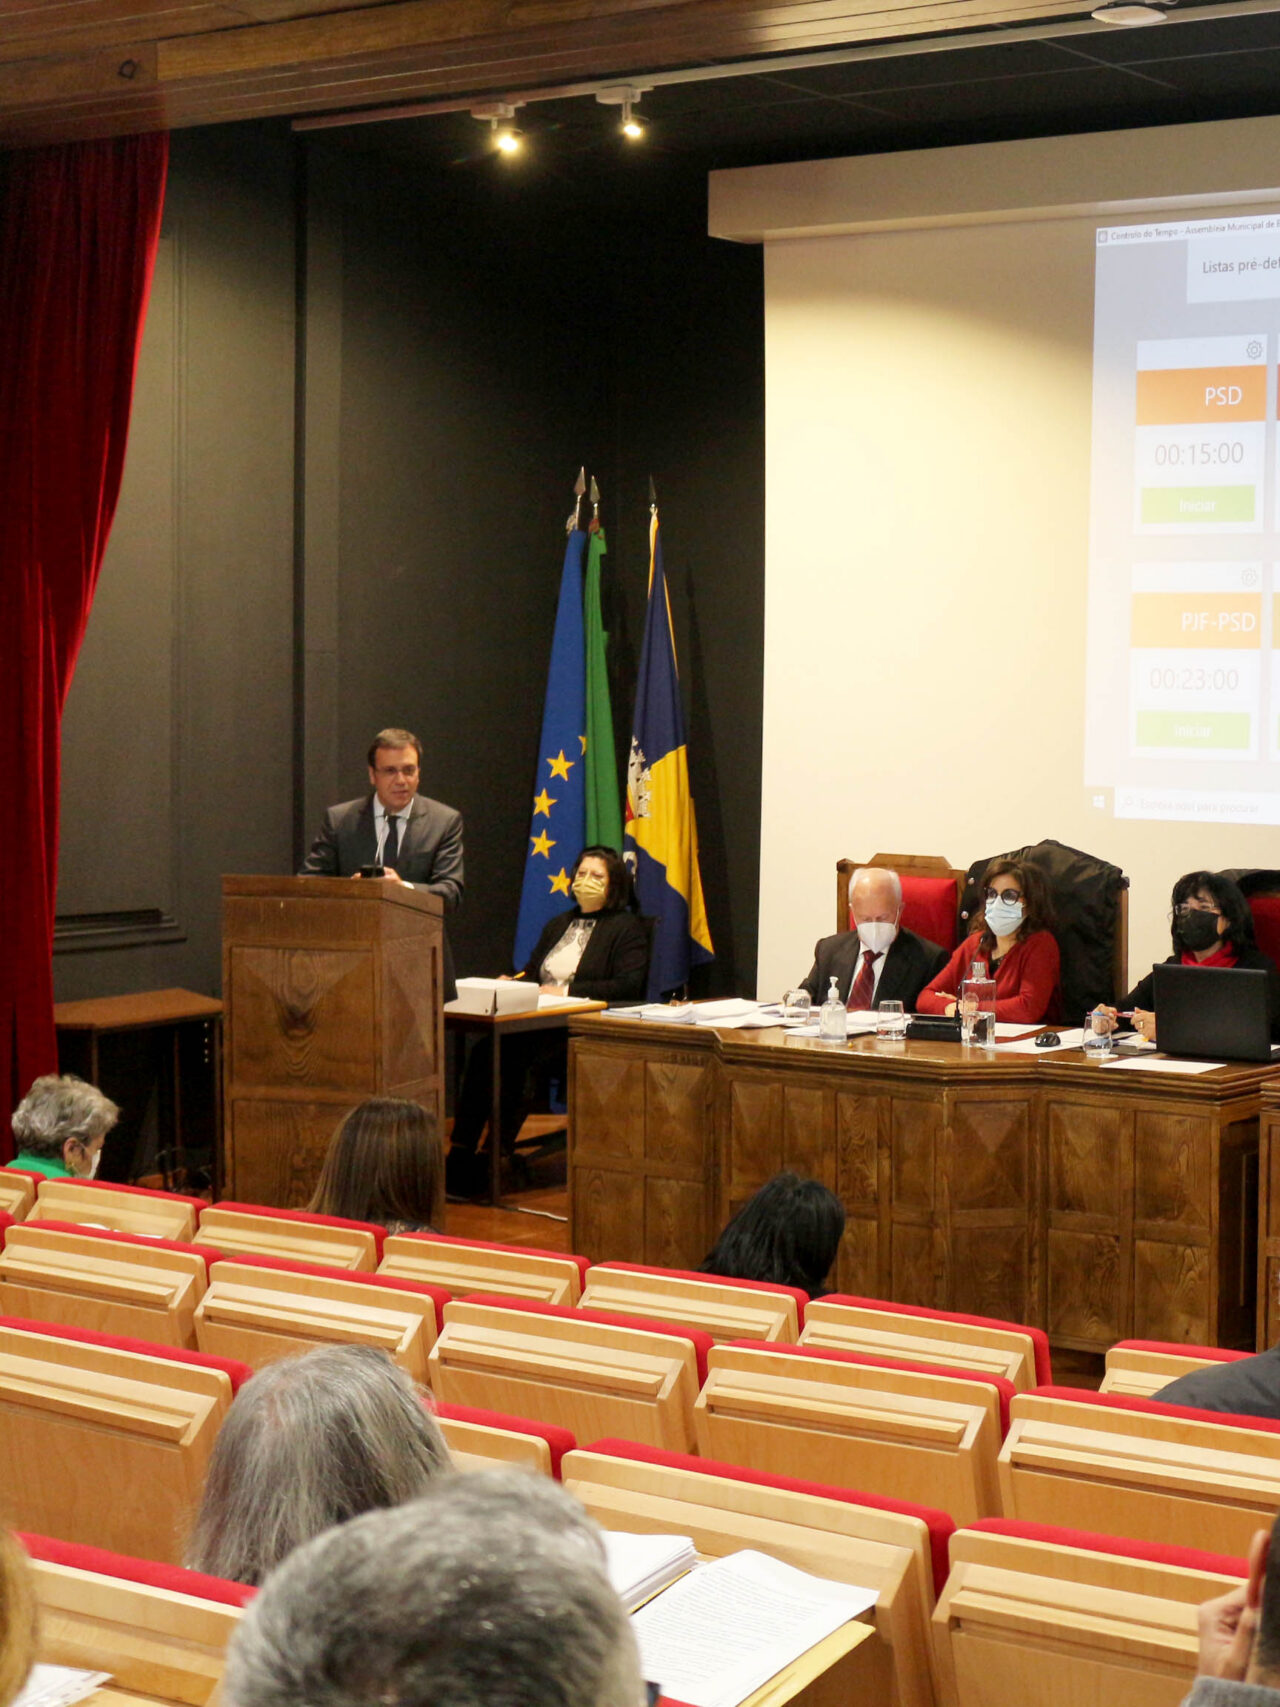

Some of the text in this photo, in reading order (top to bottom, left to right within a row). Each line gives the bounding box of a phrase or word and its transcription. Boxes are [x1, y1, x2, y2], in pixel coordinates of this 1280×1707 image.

[1227, 221, 1264, 231] Municipal
[1265, 220, 1275, 229] de
[1202, 260, 1235, 274] Listas
[1205, 386, 1243, 406] PSD
[1154, 441, 1245, 467] 00:15:00
[1179, 498, 1216, 513] Iniciar
[1181, 612, 1256, 633] PJF-PSD
[1149, 667, 1239, 692] 00:23:00
[1174, 724, 1212, 739] Iniciar
